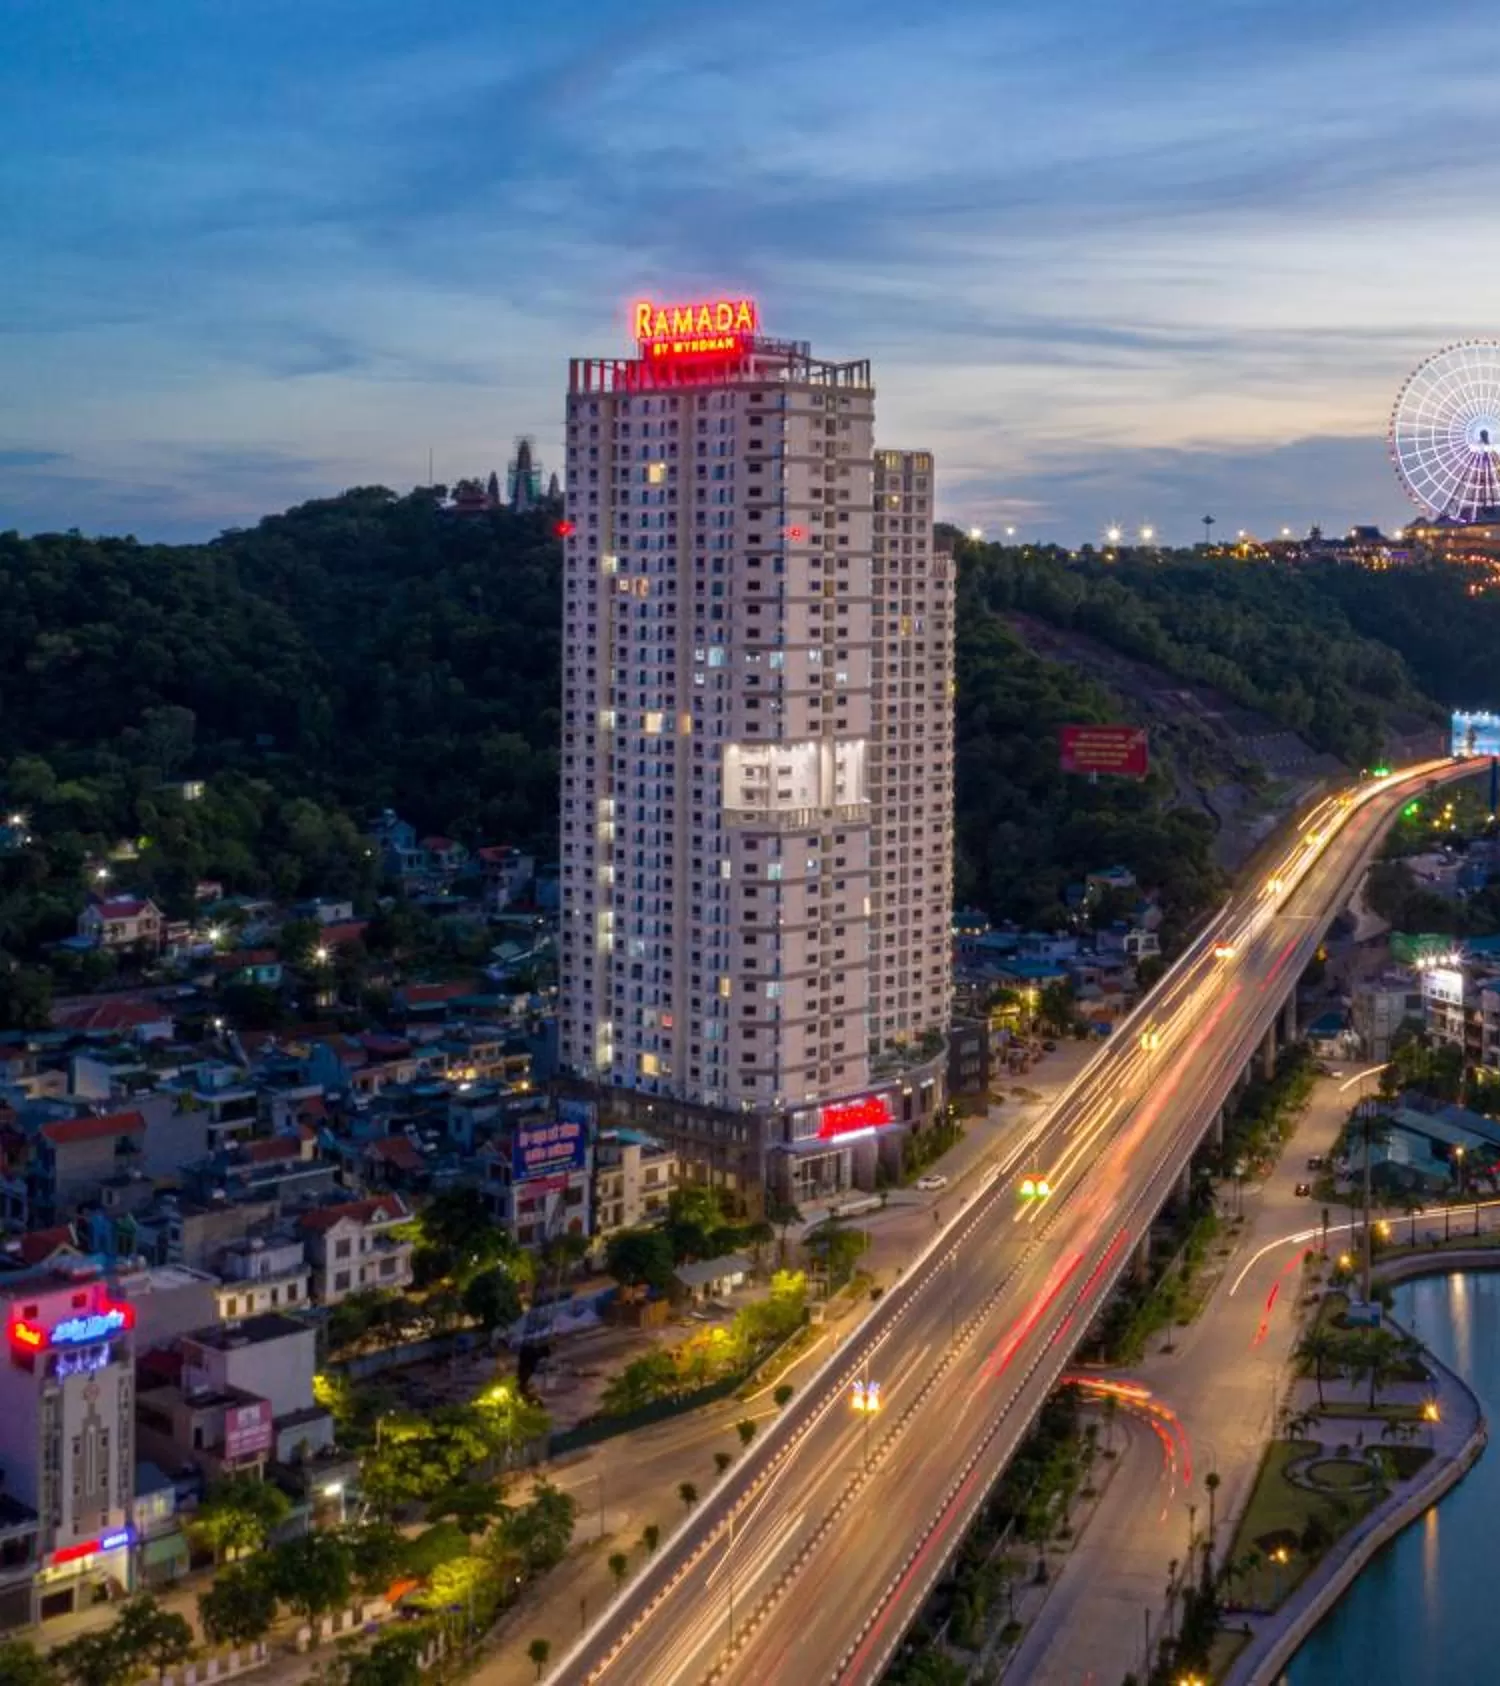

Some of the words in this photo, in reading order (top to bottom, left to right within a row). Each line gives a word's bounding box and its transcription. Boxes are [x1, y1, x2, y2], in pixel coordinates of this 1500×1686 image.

[636, 300, 752, 338] RAMADA
[653, 343, 668, 356] BY
[673, 337, 734, 353] WYNDHAM
